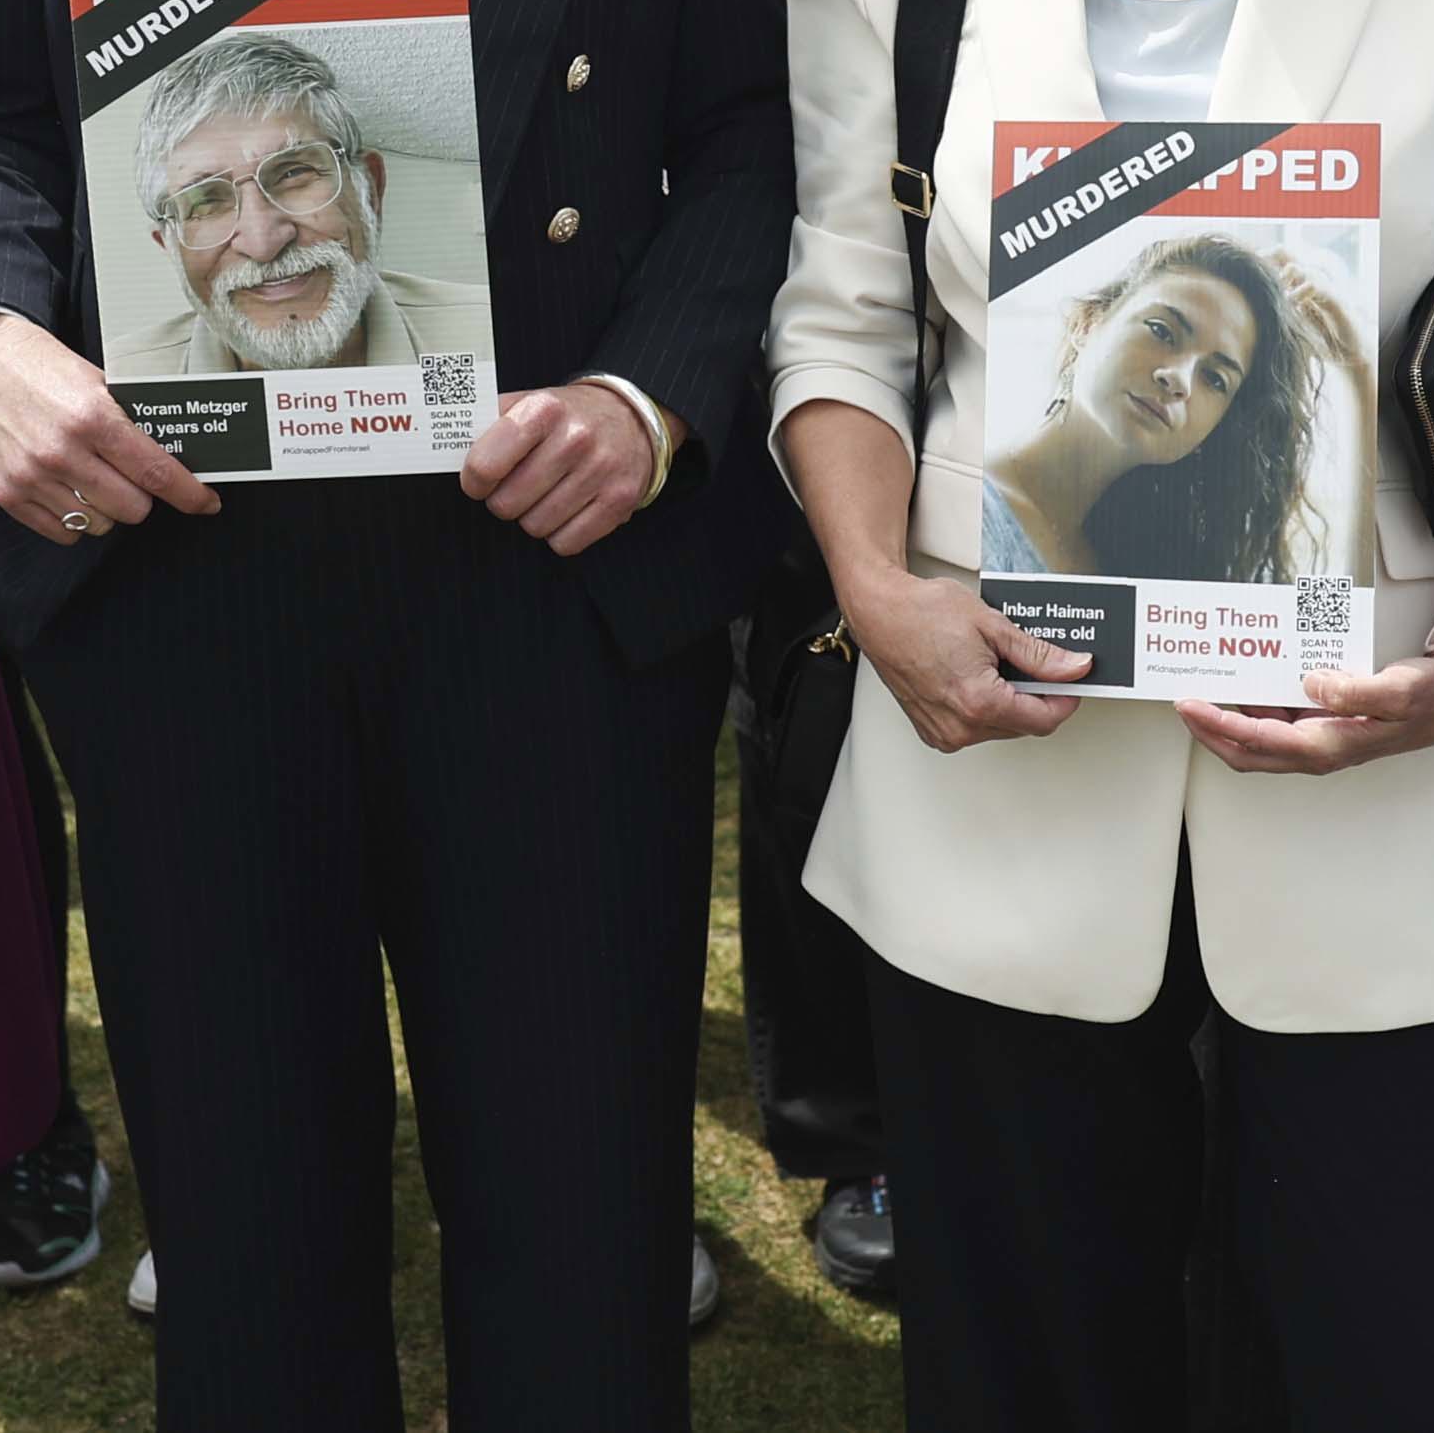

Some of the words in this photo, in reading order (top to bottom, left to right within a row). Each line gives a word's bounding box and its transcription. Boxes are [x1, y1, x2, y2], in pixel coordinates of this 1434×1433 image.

[1012, 147, 1359, 192] KPPED
[999, 130, 1196, 260] MURDERED
[132, 403, 182, 416] Yoram
[186, 400, 248, 416] Metzger
[277, 392, 338, 413] Bring
[344, 390, 407, 407] Them
[430, 411, 457, 420] SCAN
[459, 410, 472, 418] TO
[156, 423, 199, 438] years
[203, 419, 228, 433] old
[279, 419, 343, 437] Home
[350, 415, 418, 434] NOW.
[430, 421, 453, 430] JOIN
[455, 420, 473, 429] THE
[433, 431, 473, 440] GLOBAL
[1003, 601, 1042, 617] Inbar
[1046, 603, 1105, 621] Haiman
[1147, 604, 1207, 630] Bring
[1216, 607, 1278, 628] Them
[1070, 626, 1096, 641] old
[1146, 634, 1211, 655] Home
[1219, 637, 1287, 659] NOW.
[1301, 639, 1328, 648] SCAN
[1331, 639, 1343, 648] TO
[1300, 650, 1323, 660] JOIN
[1325, 651, 1343, 660] THE
